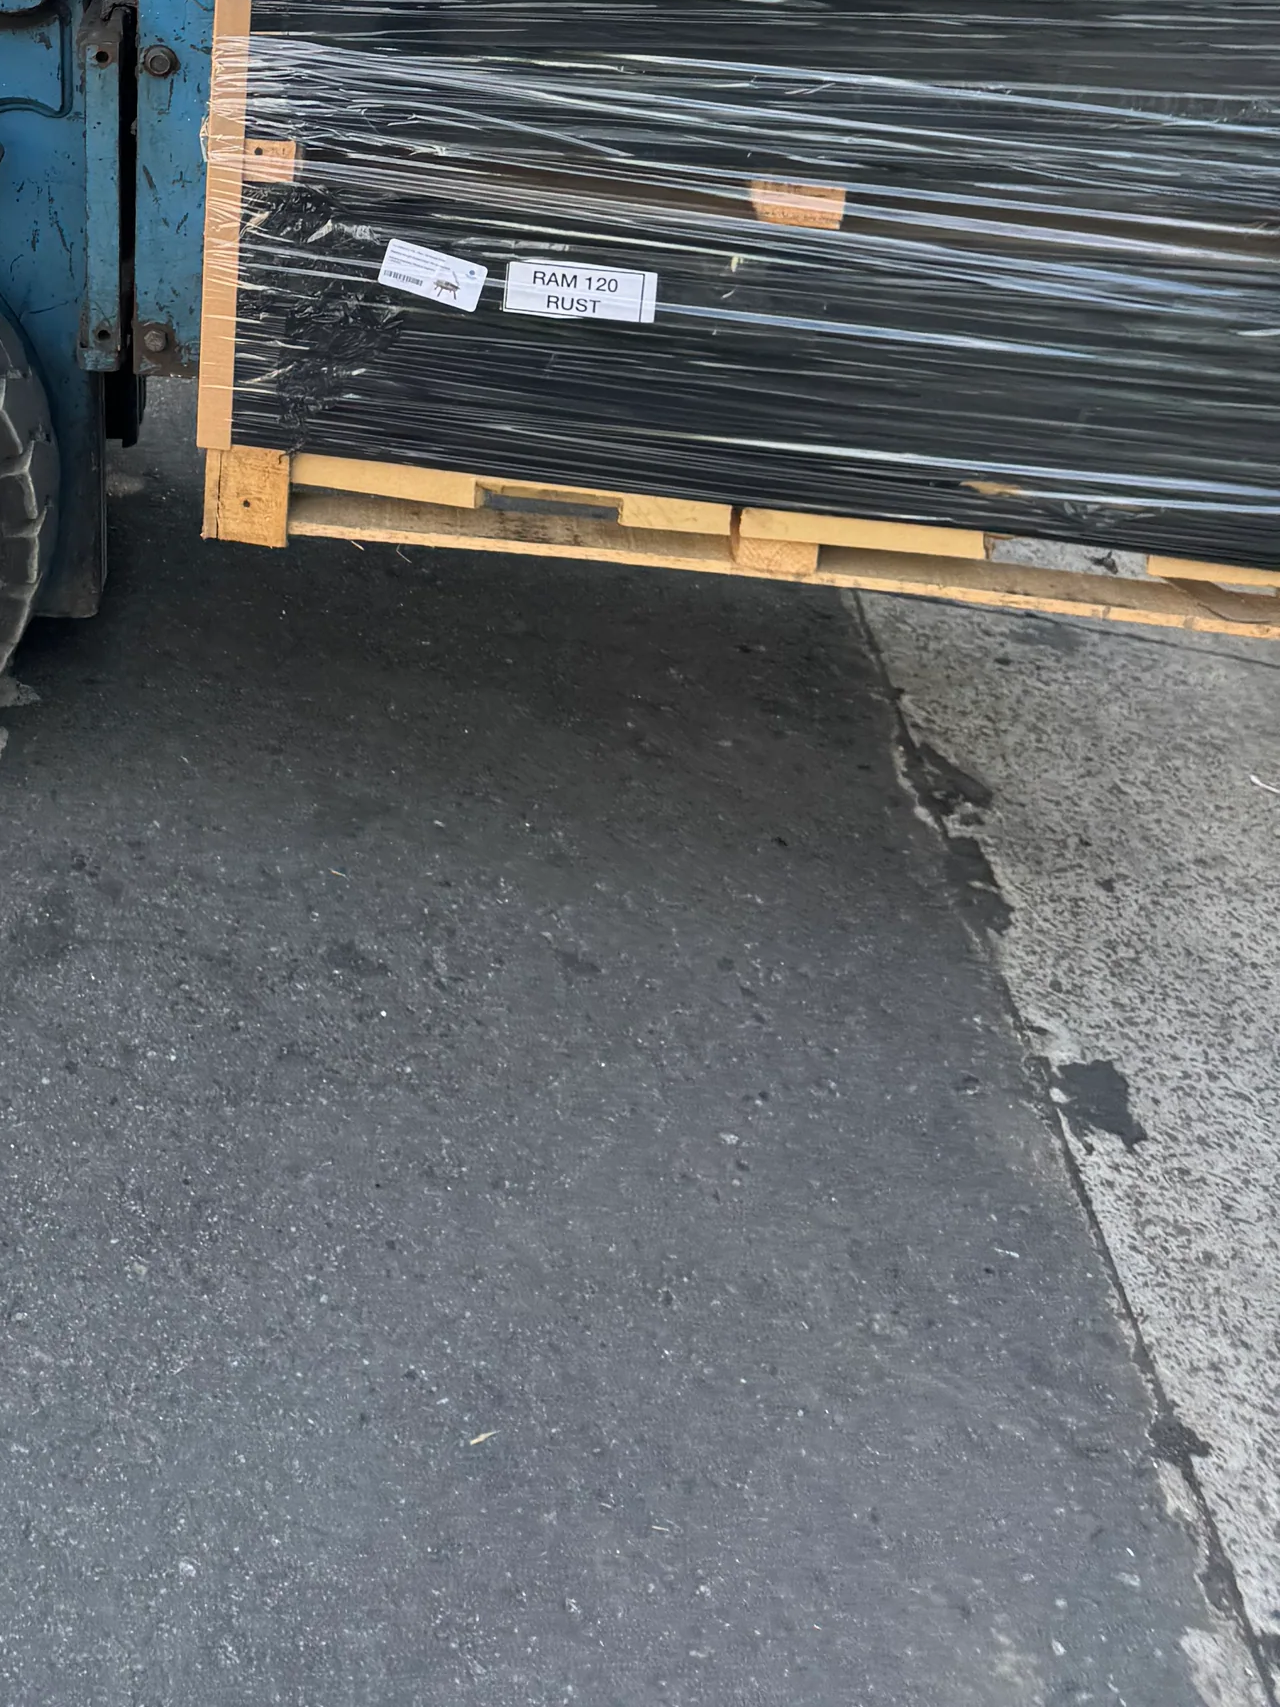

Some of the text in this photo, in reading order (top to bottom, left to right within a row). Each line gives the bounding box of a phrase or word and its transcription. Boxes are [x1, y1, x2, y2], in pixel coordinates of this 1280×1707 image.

[532, 270, 619, 294] RAM 120
[546, 296, 601, 314] RUST
